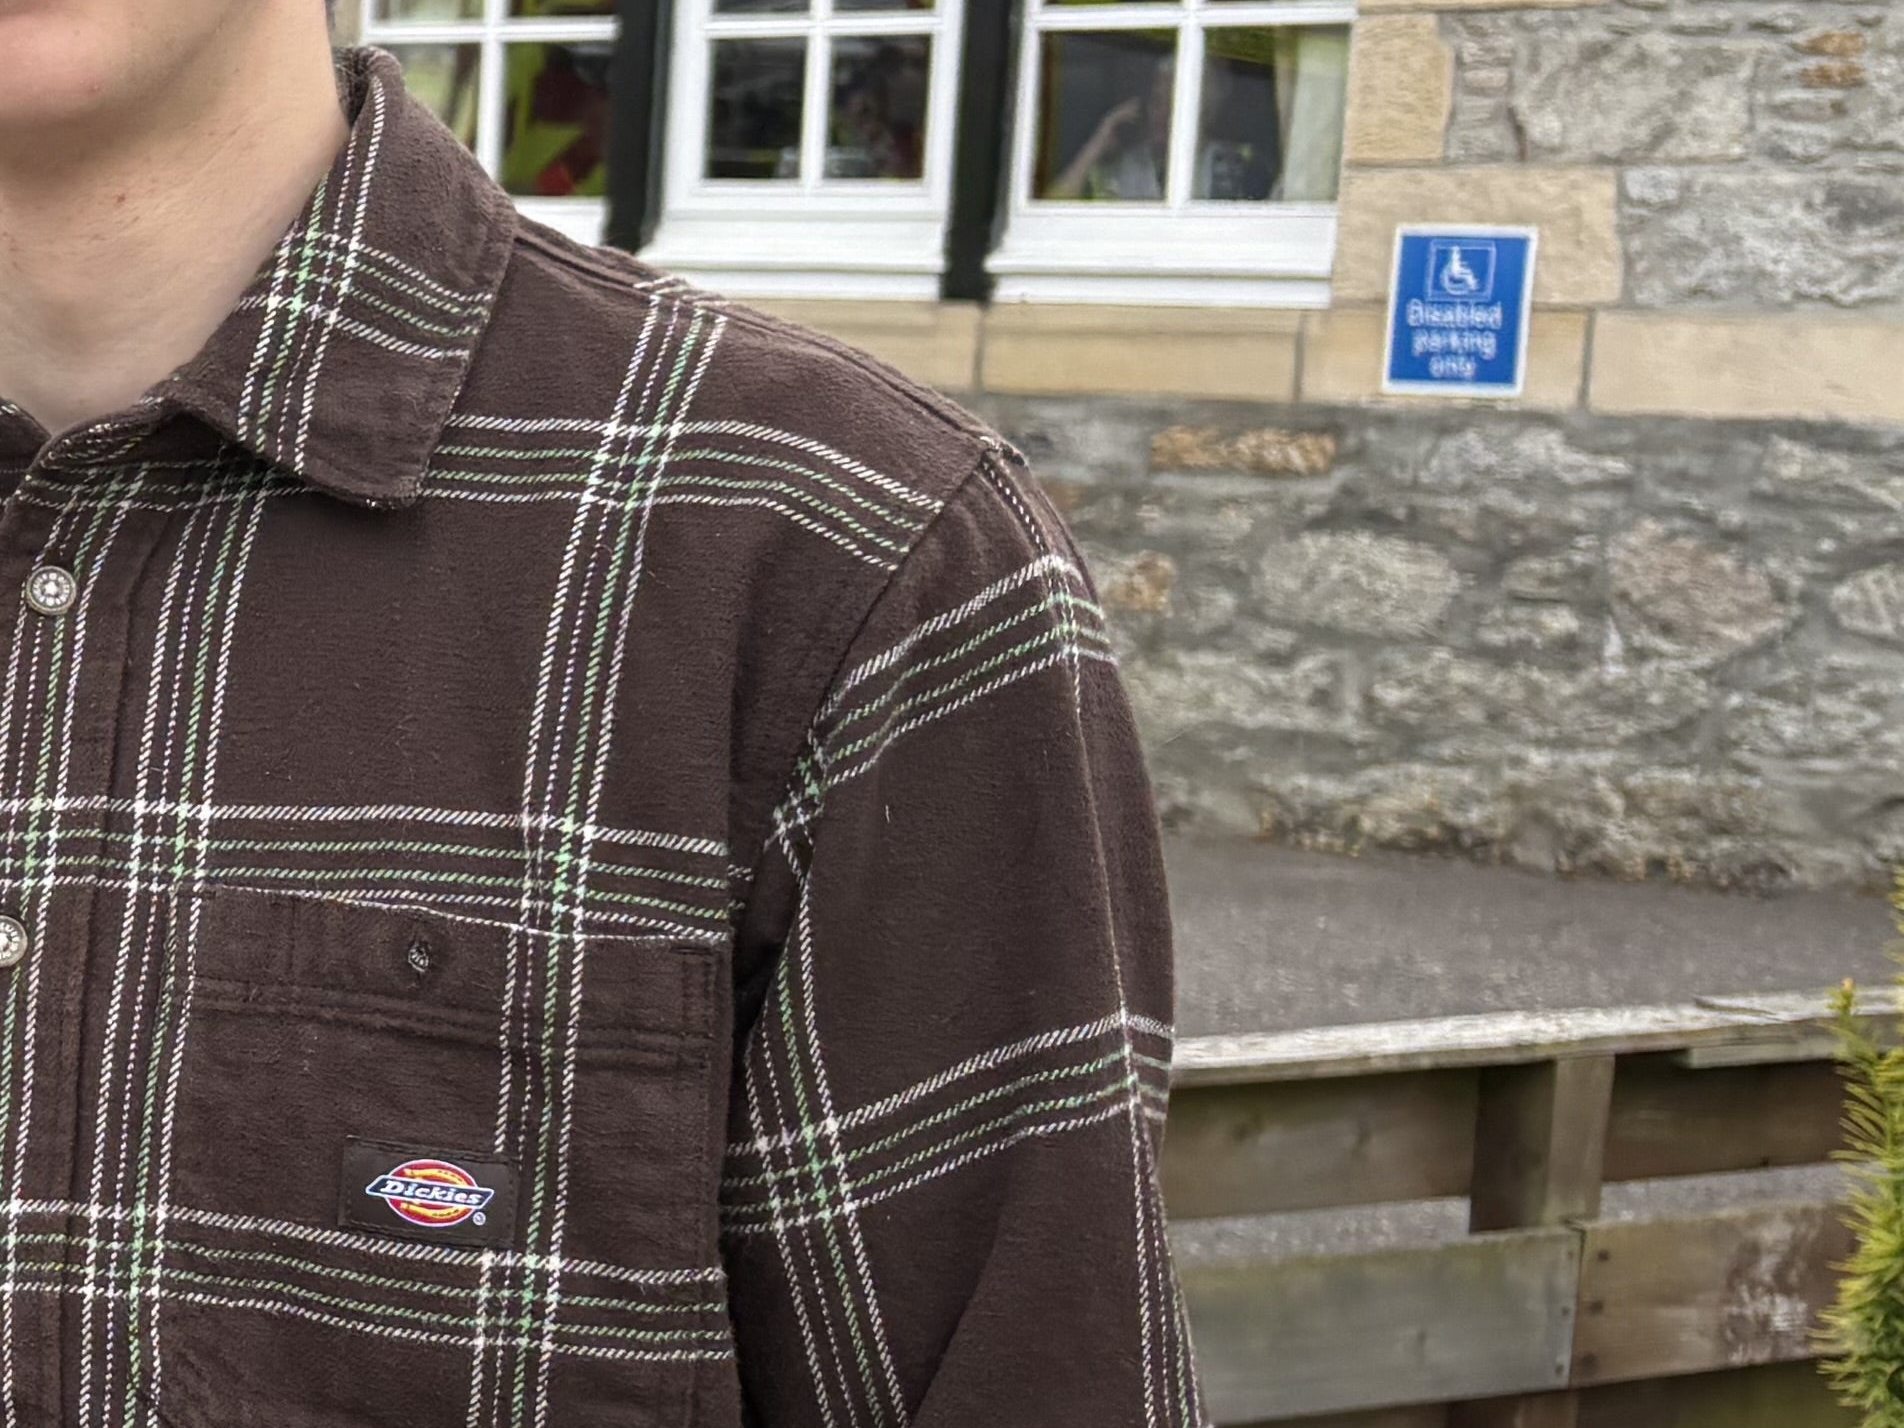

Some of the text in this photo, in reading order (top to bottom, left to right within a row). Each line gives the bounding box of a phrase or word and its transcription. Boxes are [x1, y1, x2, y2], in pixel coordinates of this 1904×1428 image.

[1406, 299, 1504, 329] Disabled
[1412, 329, 1497, 360] parking
[1429, 355, 1477, 380] only
[379, 1178, 483, 1206] Dickies
